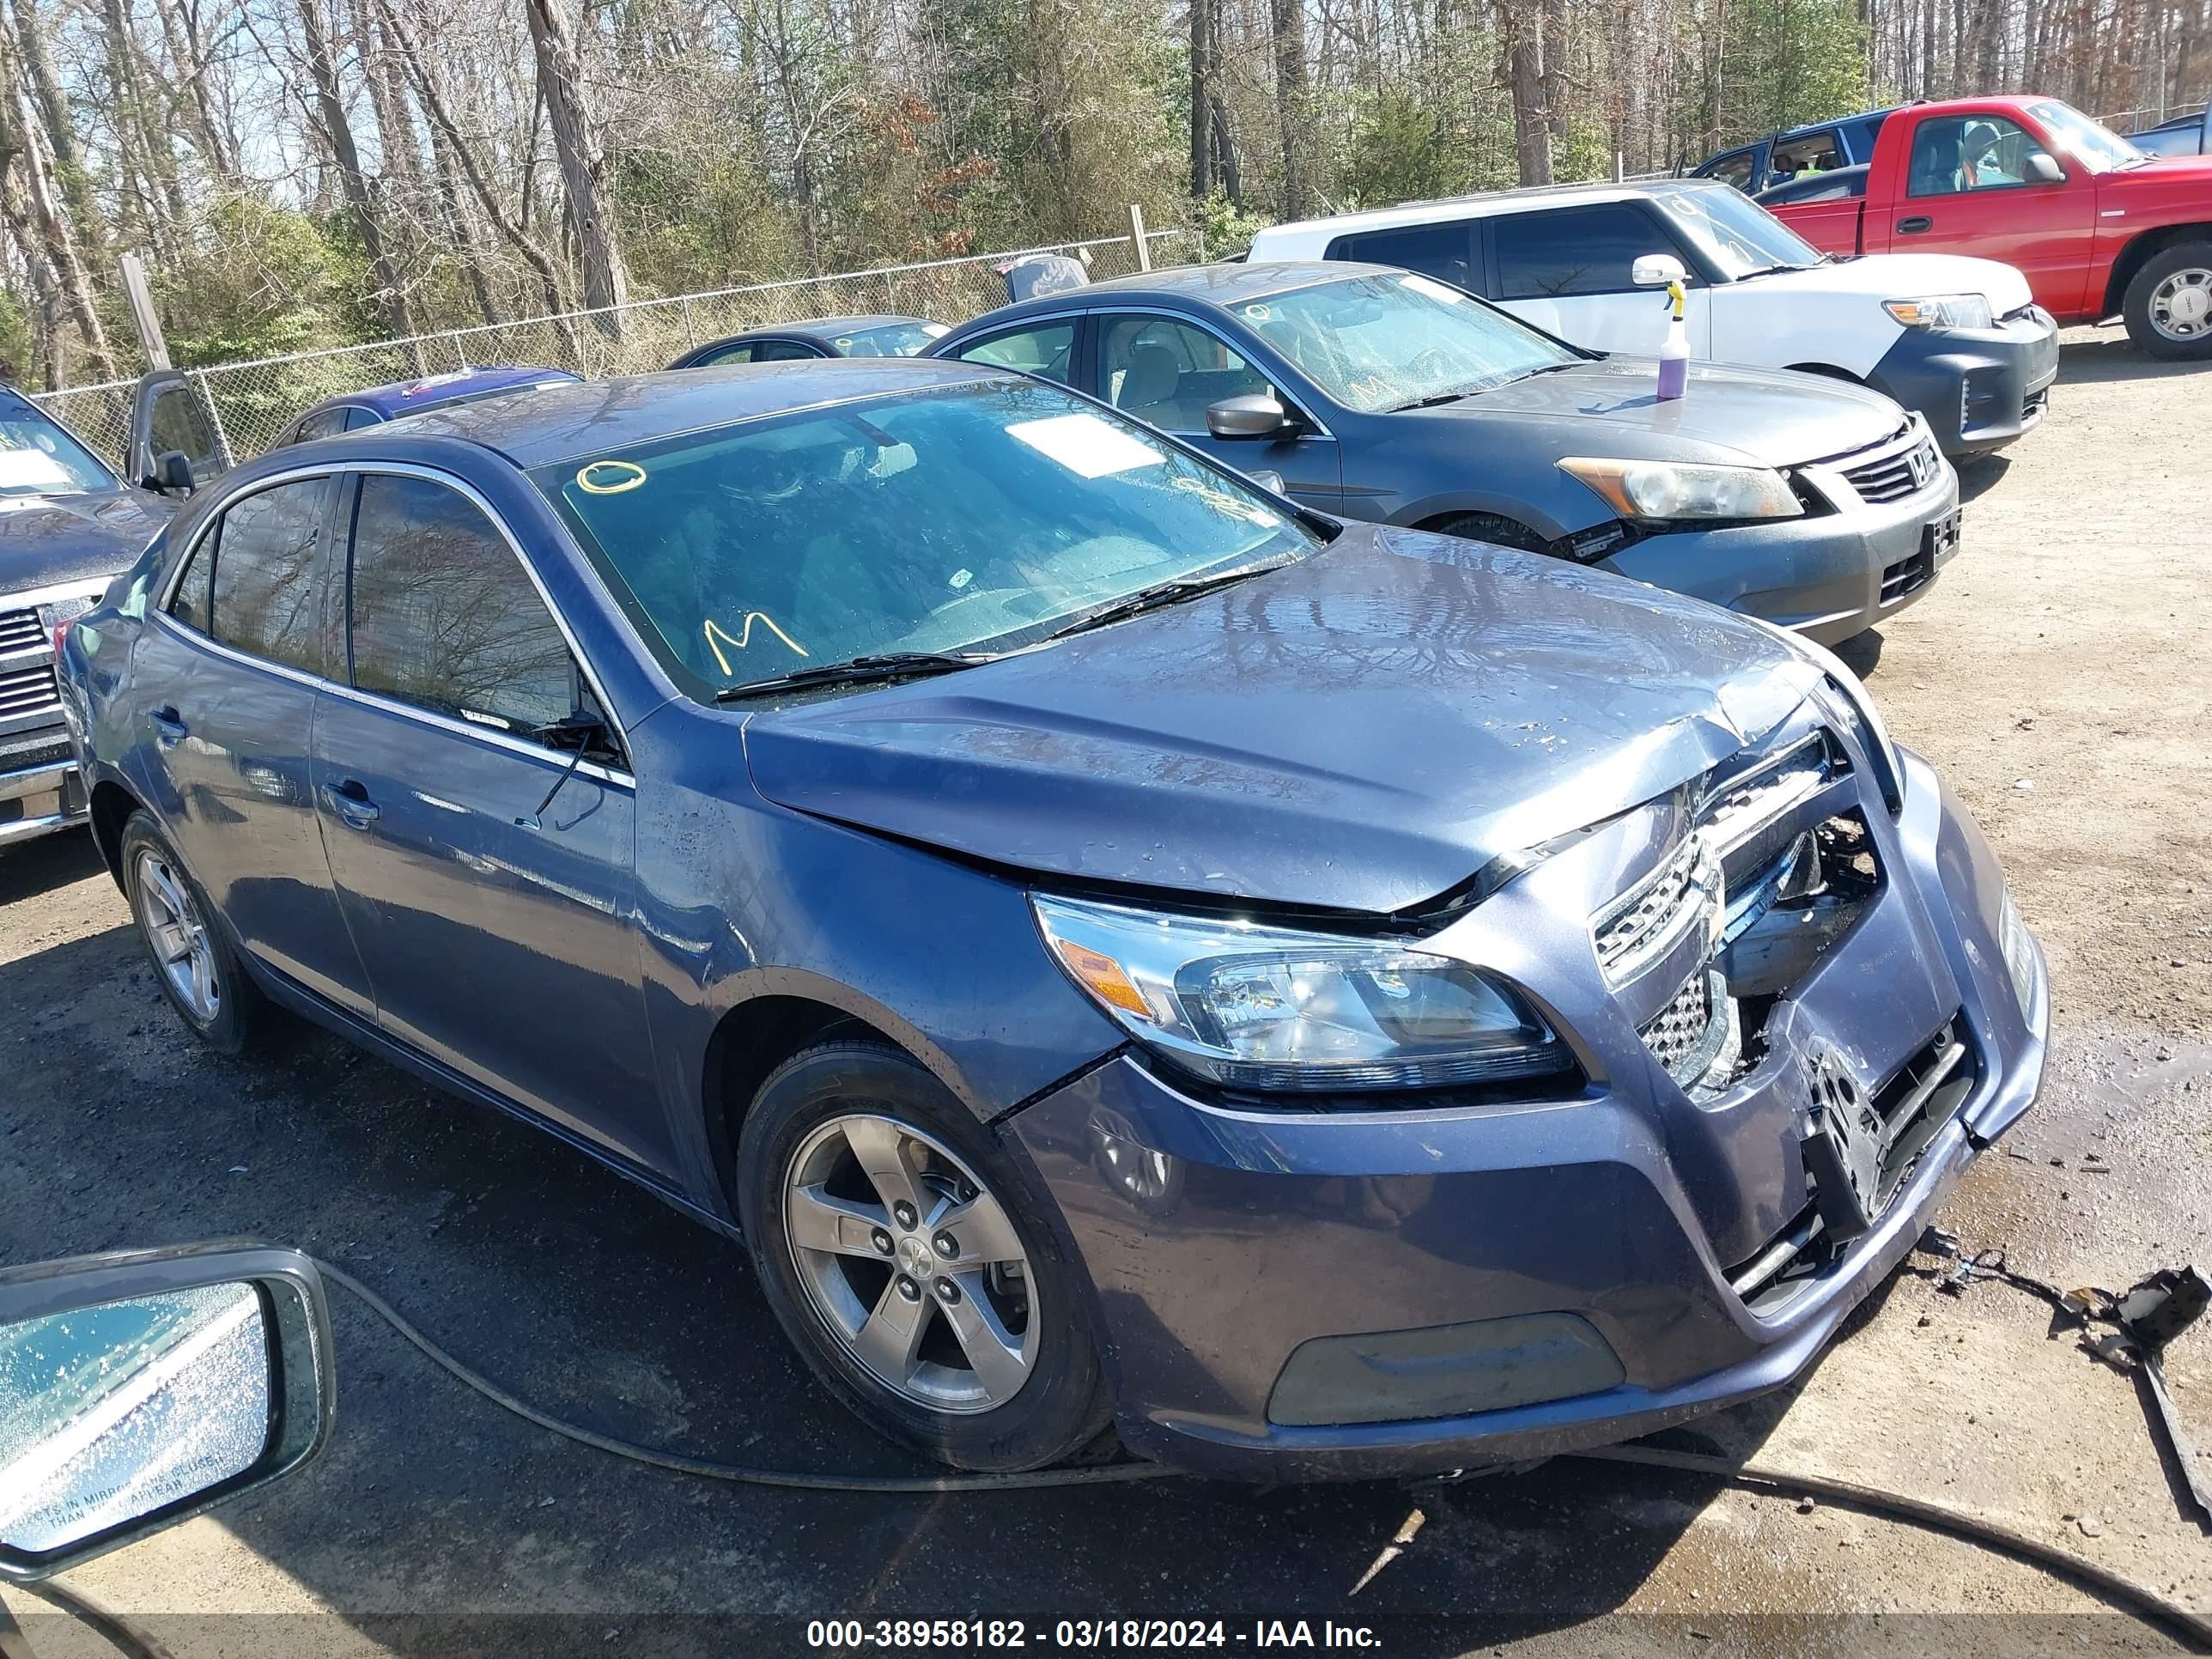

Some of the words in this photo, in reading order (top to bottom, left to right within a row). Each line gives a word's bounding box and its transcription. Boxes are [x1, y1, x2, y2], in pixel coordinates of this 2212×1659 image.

[703, 611, 810, 677] M
[67, 1498, 80, 1511] IN
[48, 1510, 85, 1528] THAN
